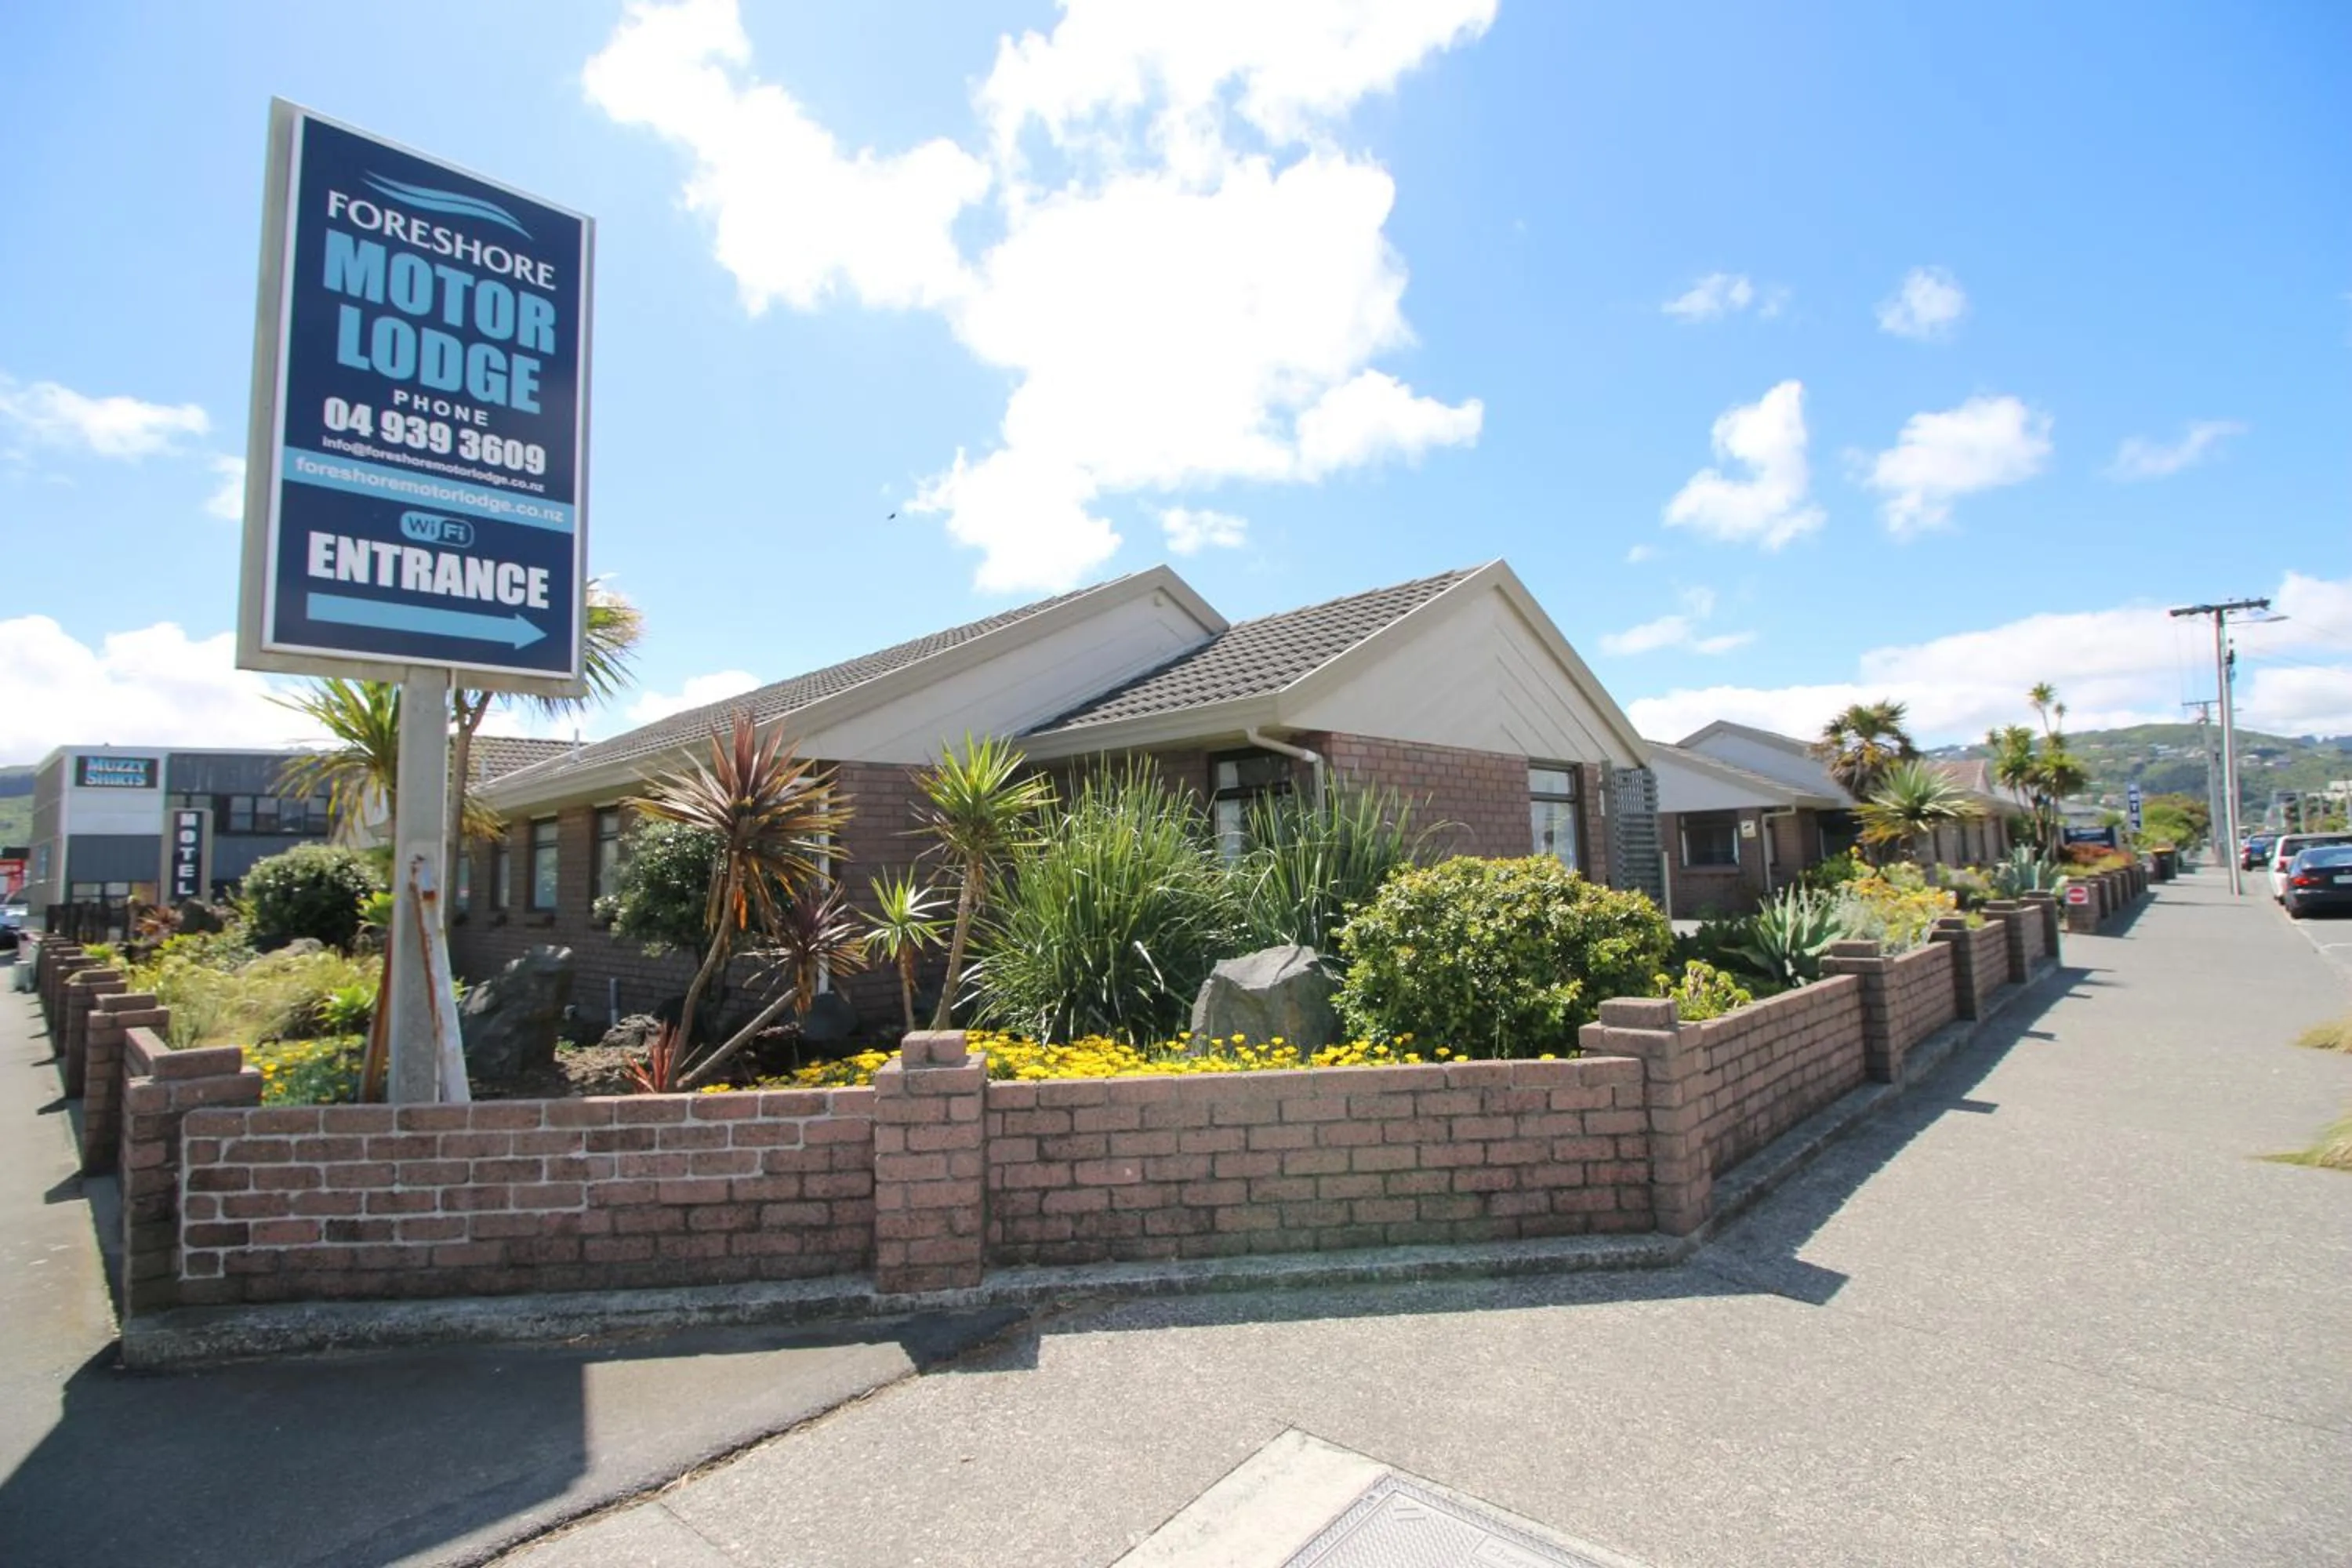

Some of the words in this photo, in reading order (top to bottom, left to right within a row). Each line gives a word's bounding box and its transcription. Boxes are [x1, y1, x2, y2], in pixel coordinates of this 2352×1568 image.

[327, 190, 556, 290] FORESHORE
[324, 228, 556, 355] MOTOR
[336, 303, 540, 414] LODGE
[324, 397, 374, 437] 04
[380, 410, 452, 455] 939
[459, 428, 546, 475] 3609
[393, 390, 489, 426] PHONE
[295, 456, 564, 523] foreshoremotorlodge.co.nz
[307, 531, 550, 609] ENTRANCE
[177, 813, 197, 895] MOTEL
